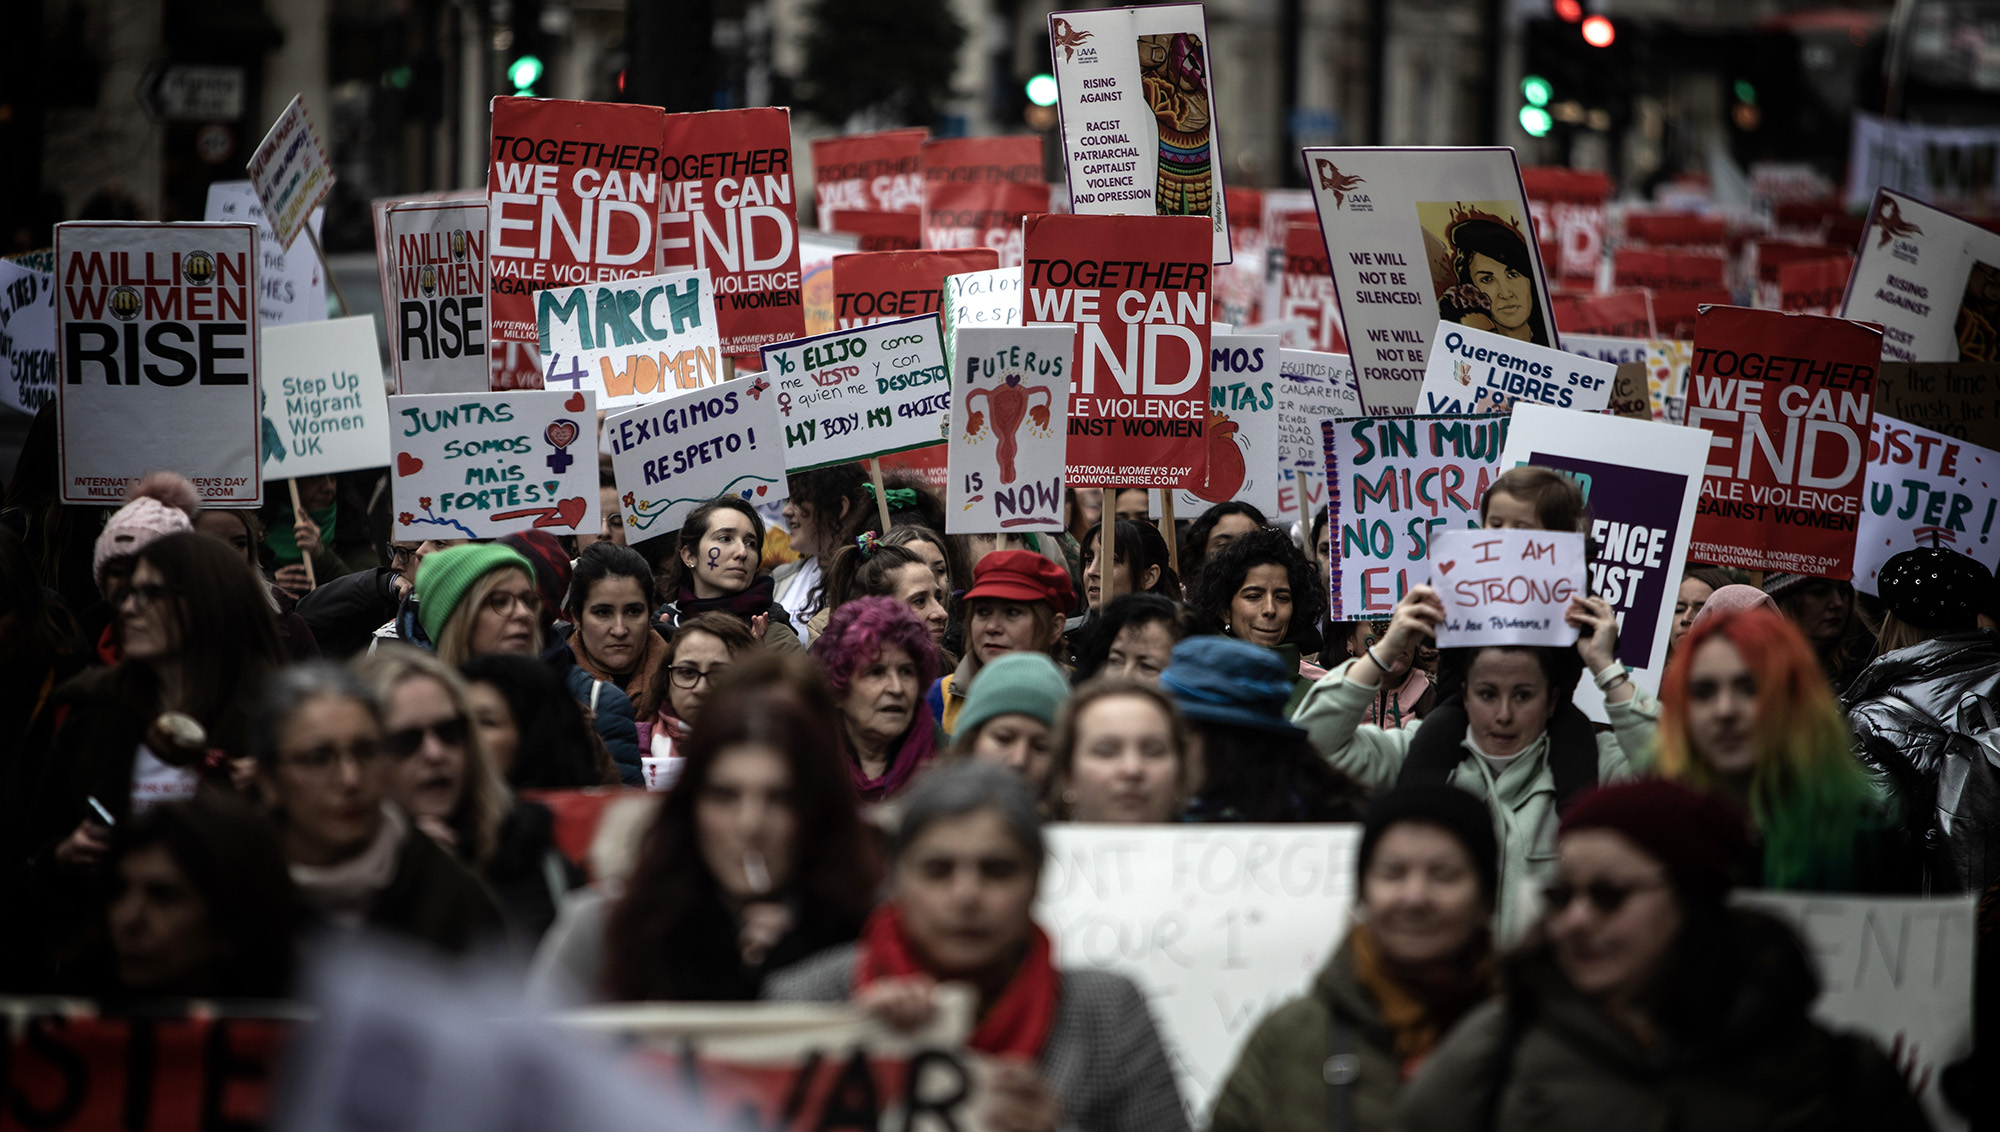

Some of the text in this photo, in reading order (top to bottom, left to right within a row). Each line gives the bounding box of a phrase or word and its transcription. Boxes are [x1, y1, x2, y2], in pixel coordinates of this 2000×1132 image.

[1083, 77, 1116, 89] RISING
[1080, 91, 1123, 104] AGAINST
[1080, 133, 1130, 147] COLONIAL
[1086, 120, 1121, 132] RACIST
[495, 136, 659, 172] TOGETHER
[661, 149, 789, 181] OGETHER
[1074, 147, 1140, 162] PATRIARCHAL
[1083, 161, 1136, 175] CAPITALIST
[495, 161, 657, 204] WE CAN
[714, 174, 792, 210] CAN
[1086, 176, 1134, 189] VIOLENCE
[1074, 189, 1152, 205] AND OPRESSION
[490, 191, 653, 266] END
[656, 205, 794, 273] END
[399, 229, 484, 266] MILLION
[1349, 252, 1408, 266] WE WILL
[65, 251, 247, 287] MILLION
[399, 263, 484, 299] WOMEN
[490, 260, 547, 281] MALE
[1027, 259, 1209, 290] TOGETHER
[1358, 271, 1407, 285] NOT BE
[260, 277, 296, 304] HES
[731, 290, 801, 311] WOMEN
[1356, 290, 1422, 305] SILENCED!
[1886, 273, 1930, 300] RISING
[65, 285, 247, 320] WOMEN
[836, 289, 946, 317] TOGETH
[957, 305, 1022, 328] Resp
[1029, 287, 1207, 326] WE CAN
[1875, 287, 1932, 319] AGAINST
[400, 297, 485, 361] RISE
[538, 278, 702, 357] MARCH
[733, 334, 774, 346] WOMEN'S
[776, 332, 796, 343] DAY
[1367, 329, 1424, 344] WE WILL
[1880, 320, 1916, 347] CIST
[10, 350, 56, 386] SOMEON
[65, 322, 249, 387] RISE
[773, 334, 924, 377] Yo ELIJO como
[966, 346, 1063, 385] FUTERUS
[1211, 347, 1264, 373] MOS
[1376, 348, 1424, 363] NOT BE
[1445, 332, 1554, 379] Queremos
[1567, 370, 1606, 392] ser
[282, 371, 359, 397] Step Up
[546, 352, 590, 390] 4
[599, 345, 718, 398] WOMEN
[780, 376, 804, 391] me
[811, 365, 860, 388] VISTO
[892, 353, 922, 369] con
[1279, 361, 1343, 380] EGUIMOS DE
[1364, 367, 1426, 382] FORGOTT
[1696, 348, 1875, 392] TOGETHER
[1905, 367, 1936, 393] the
[1944, 367, 1988, 395] time
[798, 364, 947, 409] quien me DESVISTO
[1211, 381, 1274, 413] NTAS
[1280, 384, 1356, 402] CANSAREMOS
[1486, 366, 1574, 408] LIBRES
[1695, 374, 1765, 414] WE
[1778, 384, 1871, 426] CAN
[286, 391, 362, 418] Migrant
[1096, 398, 1205, 420] VIOLENCE
[1299, 404, 1345, 417] NUESTROS
[1895, 398, 1951, 419] finish
[1960, 399, 1986, 421] the
[288, 415, 364, 436] Women
[401, 402, 514, 438] JUNTAS
[610, 392, 739, 455] ¡EXIGIMOS
[784, 418, 817, 450] MY
[866, 405, 893, 429] MY
[1067, 418, 1203, 438] INST WOMEN
[293, 436, 323, 457] UK
[443, 436, 532, 460] SOMOS
[1351, 417, 1512, 466] SIN MUJ
[1687, 405, 1863, 491] END
[223, 477, 248, 487] DAY
[965, 472, 984, 494] IS
[1064, 474, 1180, 486] LIONWOMENRISE.COM
[1065, 465, 1192, 477] NATIONAL WOMEN'S DAY
[994, 476, 1061, 518] NOW
[1353, 464, 1500, 517] MIGRA
[1700, 480, 1859, 516] ALE VIOLENCE
[1696, 497, 1856, 532] GAINST WOMEN
[1862, 479, 1998, 544] UJER!
[1341, 518, 1395, 560] NO
[1472, 539, 1556, 565] I AM
[1590, 518, 1668, 569] ENCE
[1688, 541, 1841, 569] NTERNATIONAL WOMEN'S DAY
[1693, 550, 1827, 576] MILLIONWOMENRISE.COM
[1455, 575, 1578, 608] STRONG
[1172, 833, 1358, 898] FORGE
